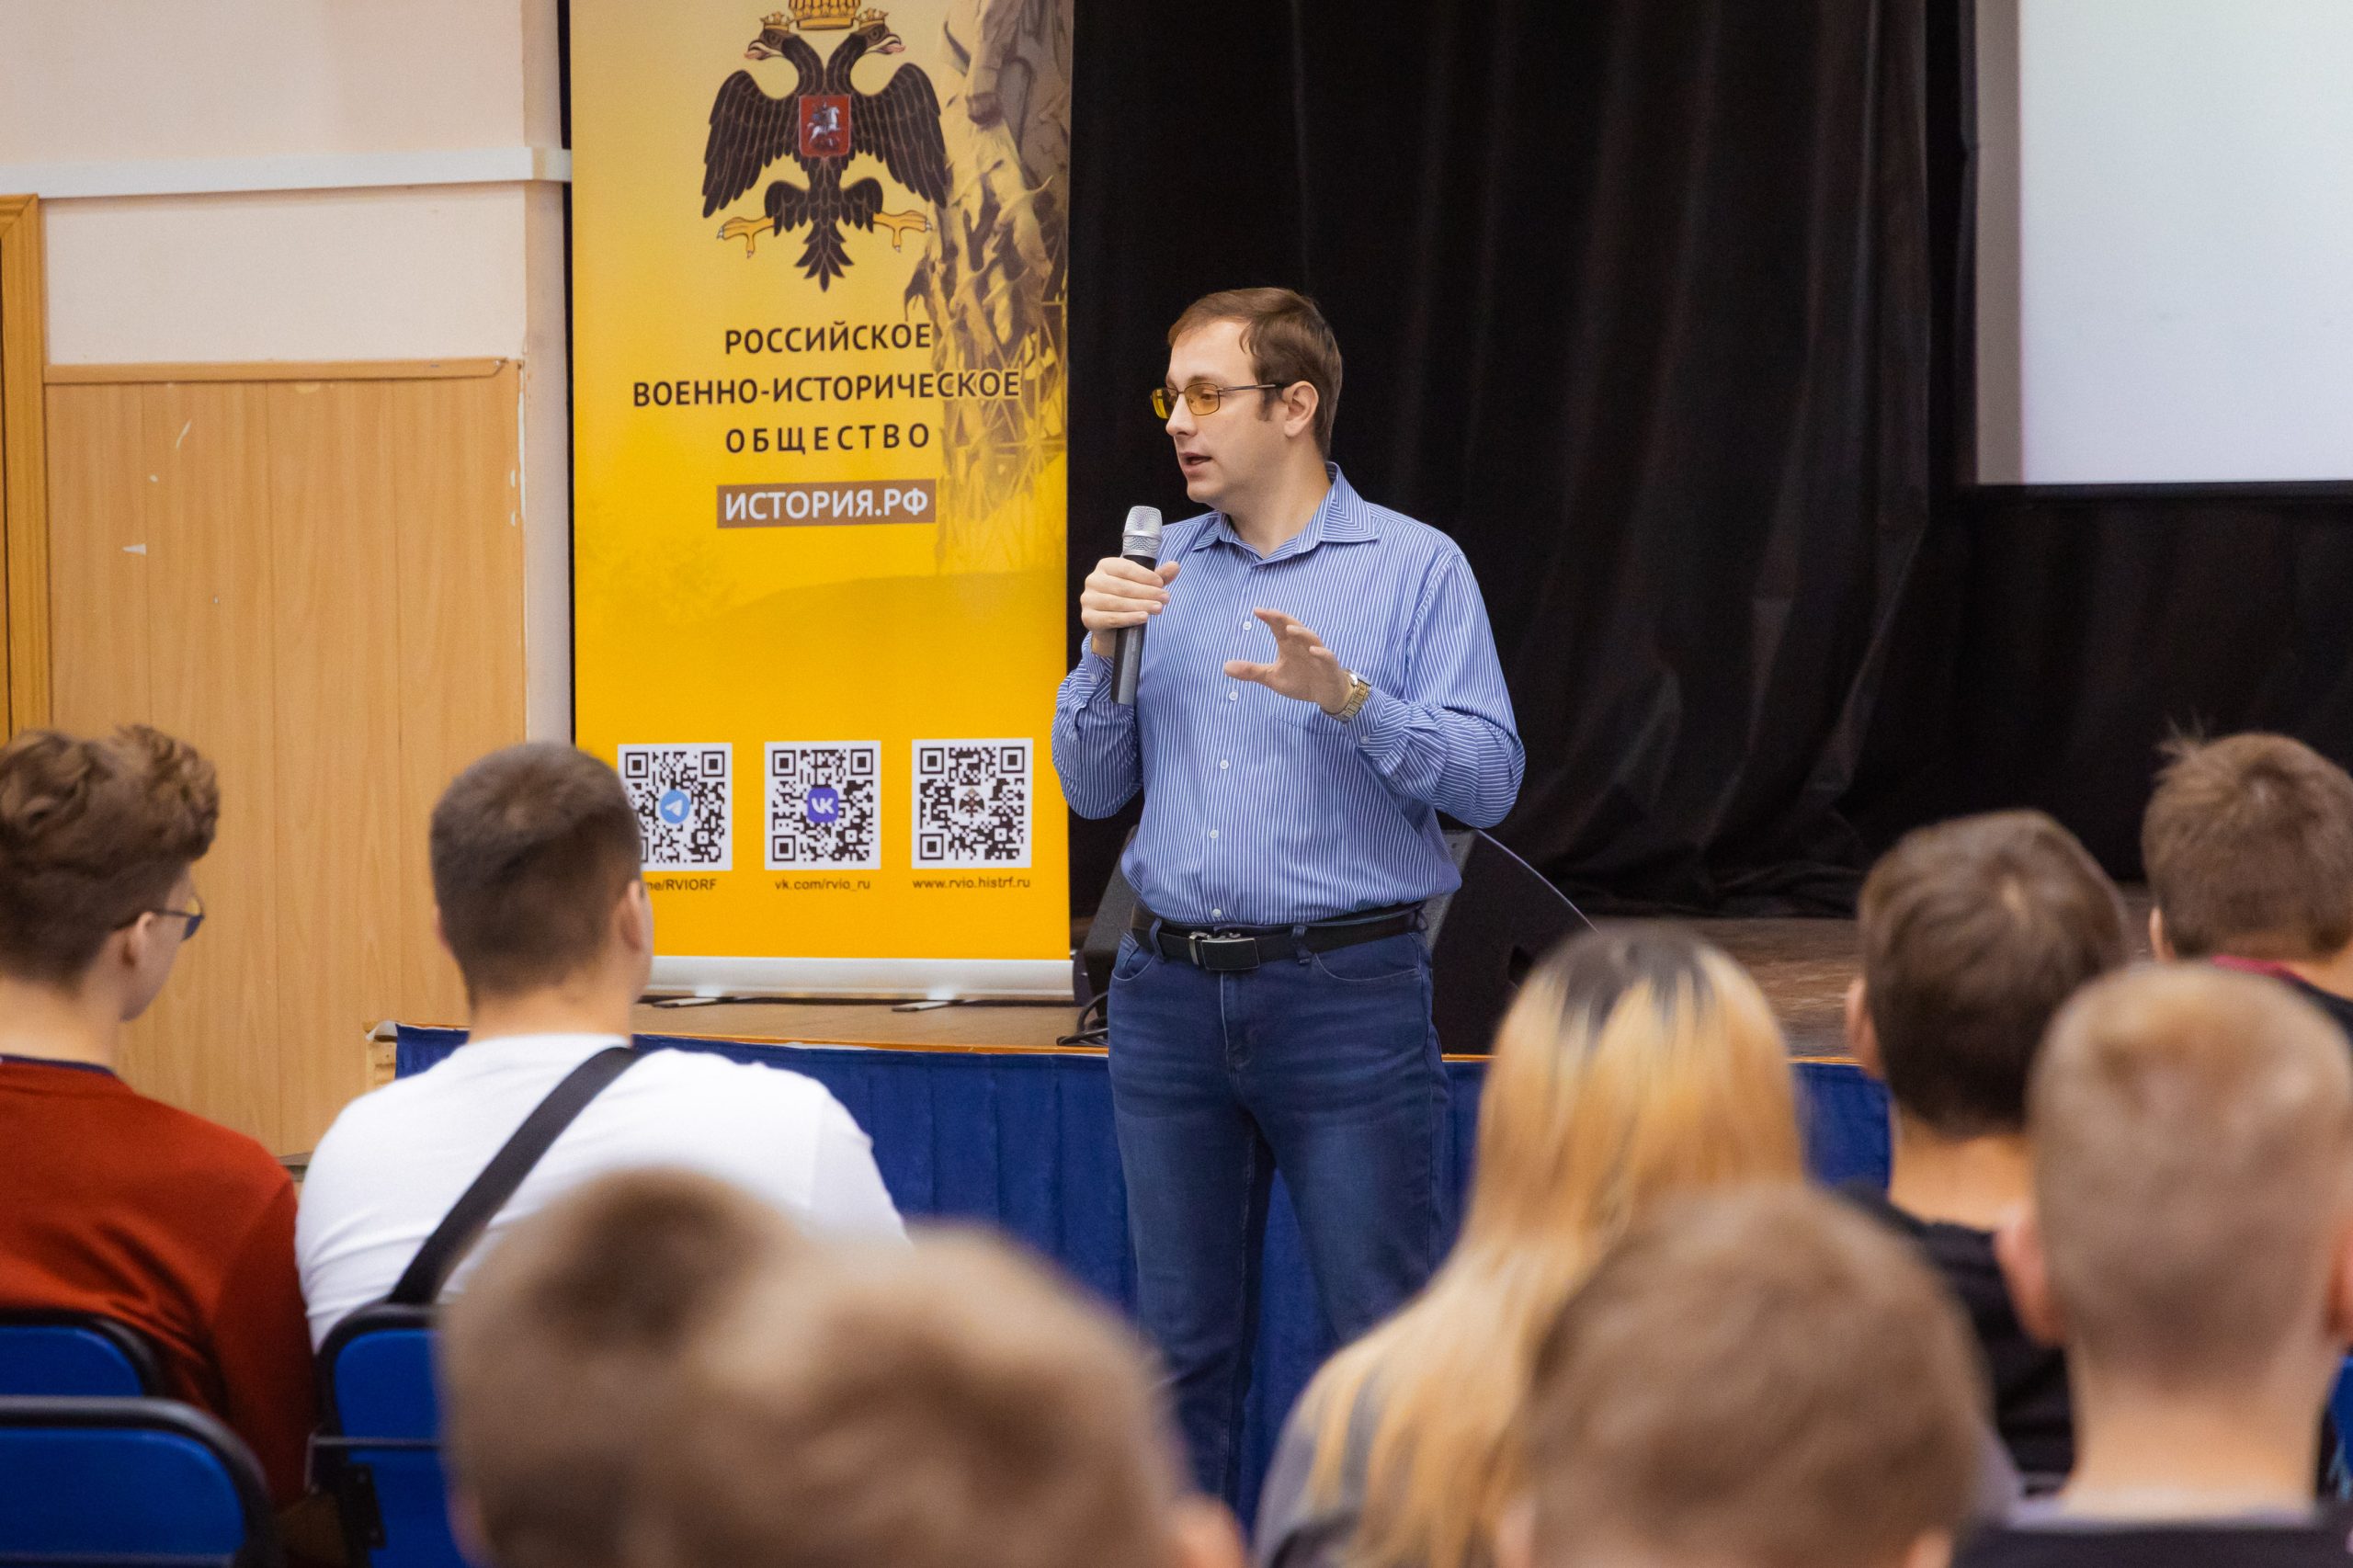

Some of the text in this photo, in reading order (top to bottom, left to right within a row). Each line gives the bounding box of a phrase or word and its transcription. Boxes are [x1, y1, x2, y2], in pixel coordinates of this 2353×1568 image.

[725, 322, 930, 354] РОССИЙСКОЕ
[633, 371, 1020, 406] ВОЕННО-ИСТОРИЧЕСКОЕ
[726, 423, 930, 454] ОБЩЕСТВО
[725, 488, 928, 521] ИСТОРИЯ.РФ
[775, 878, 870, 892] vk.com/rvio_ru
[912, 877, 1030, 889] www.rvio.histrf.ru
